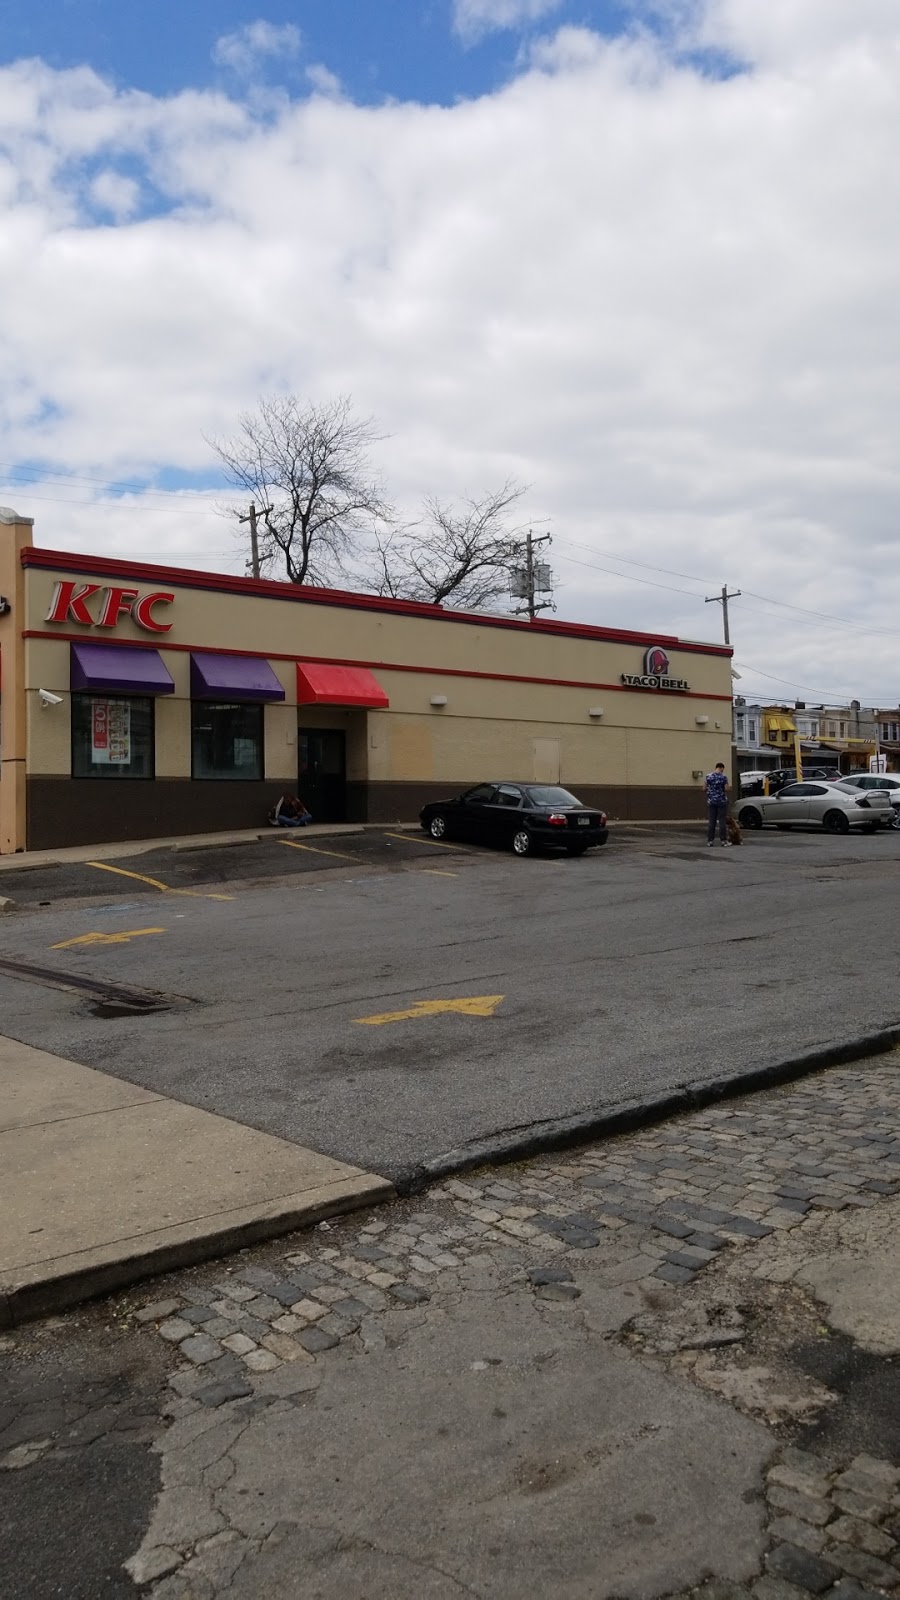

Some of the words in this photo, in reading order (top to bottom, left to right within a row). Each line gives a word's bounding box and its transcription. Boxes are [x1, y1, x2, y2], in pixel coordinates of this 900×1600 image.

[45, 581, 175, 633] KFC
[625, 674, 658, 687] TACO
[661, 678, 691, 690] BELL
